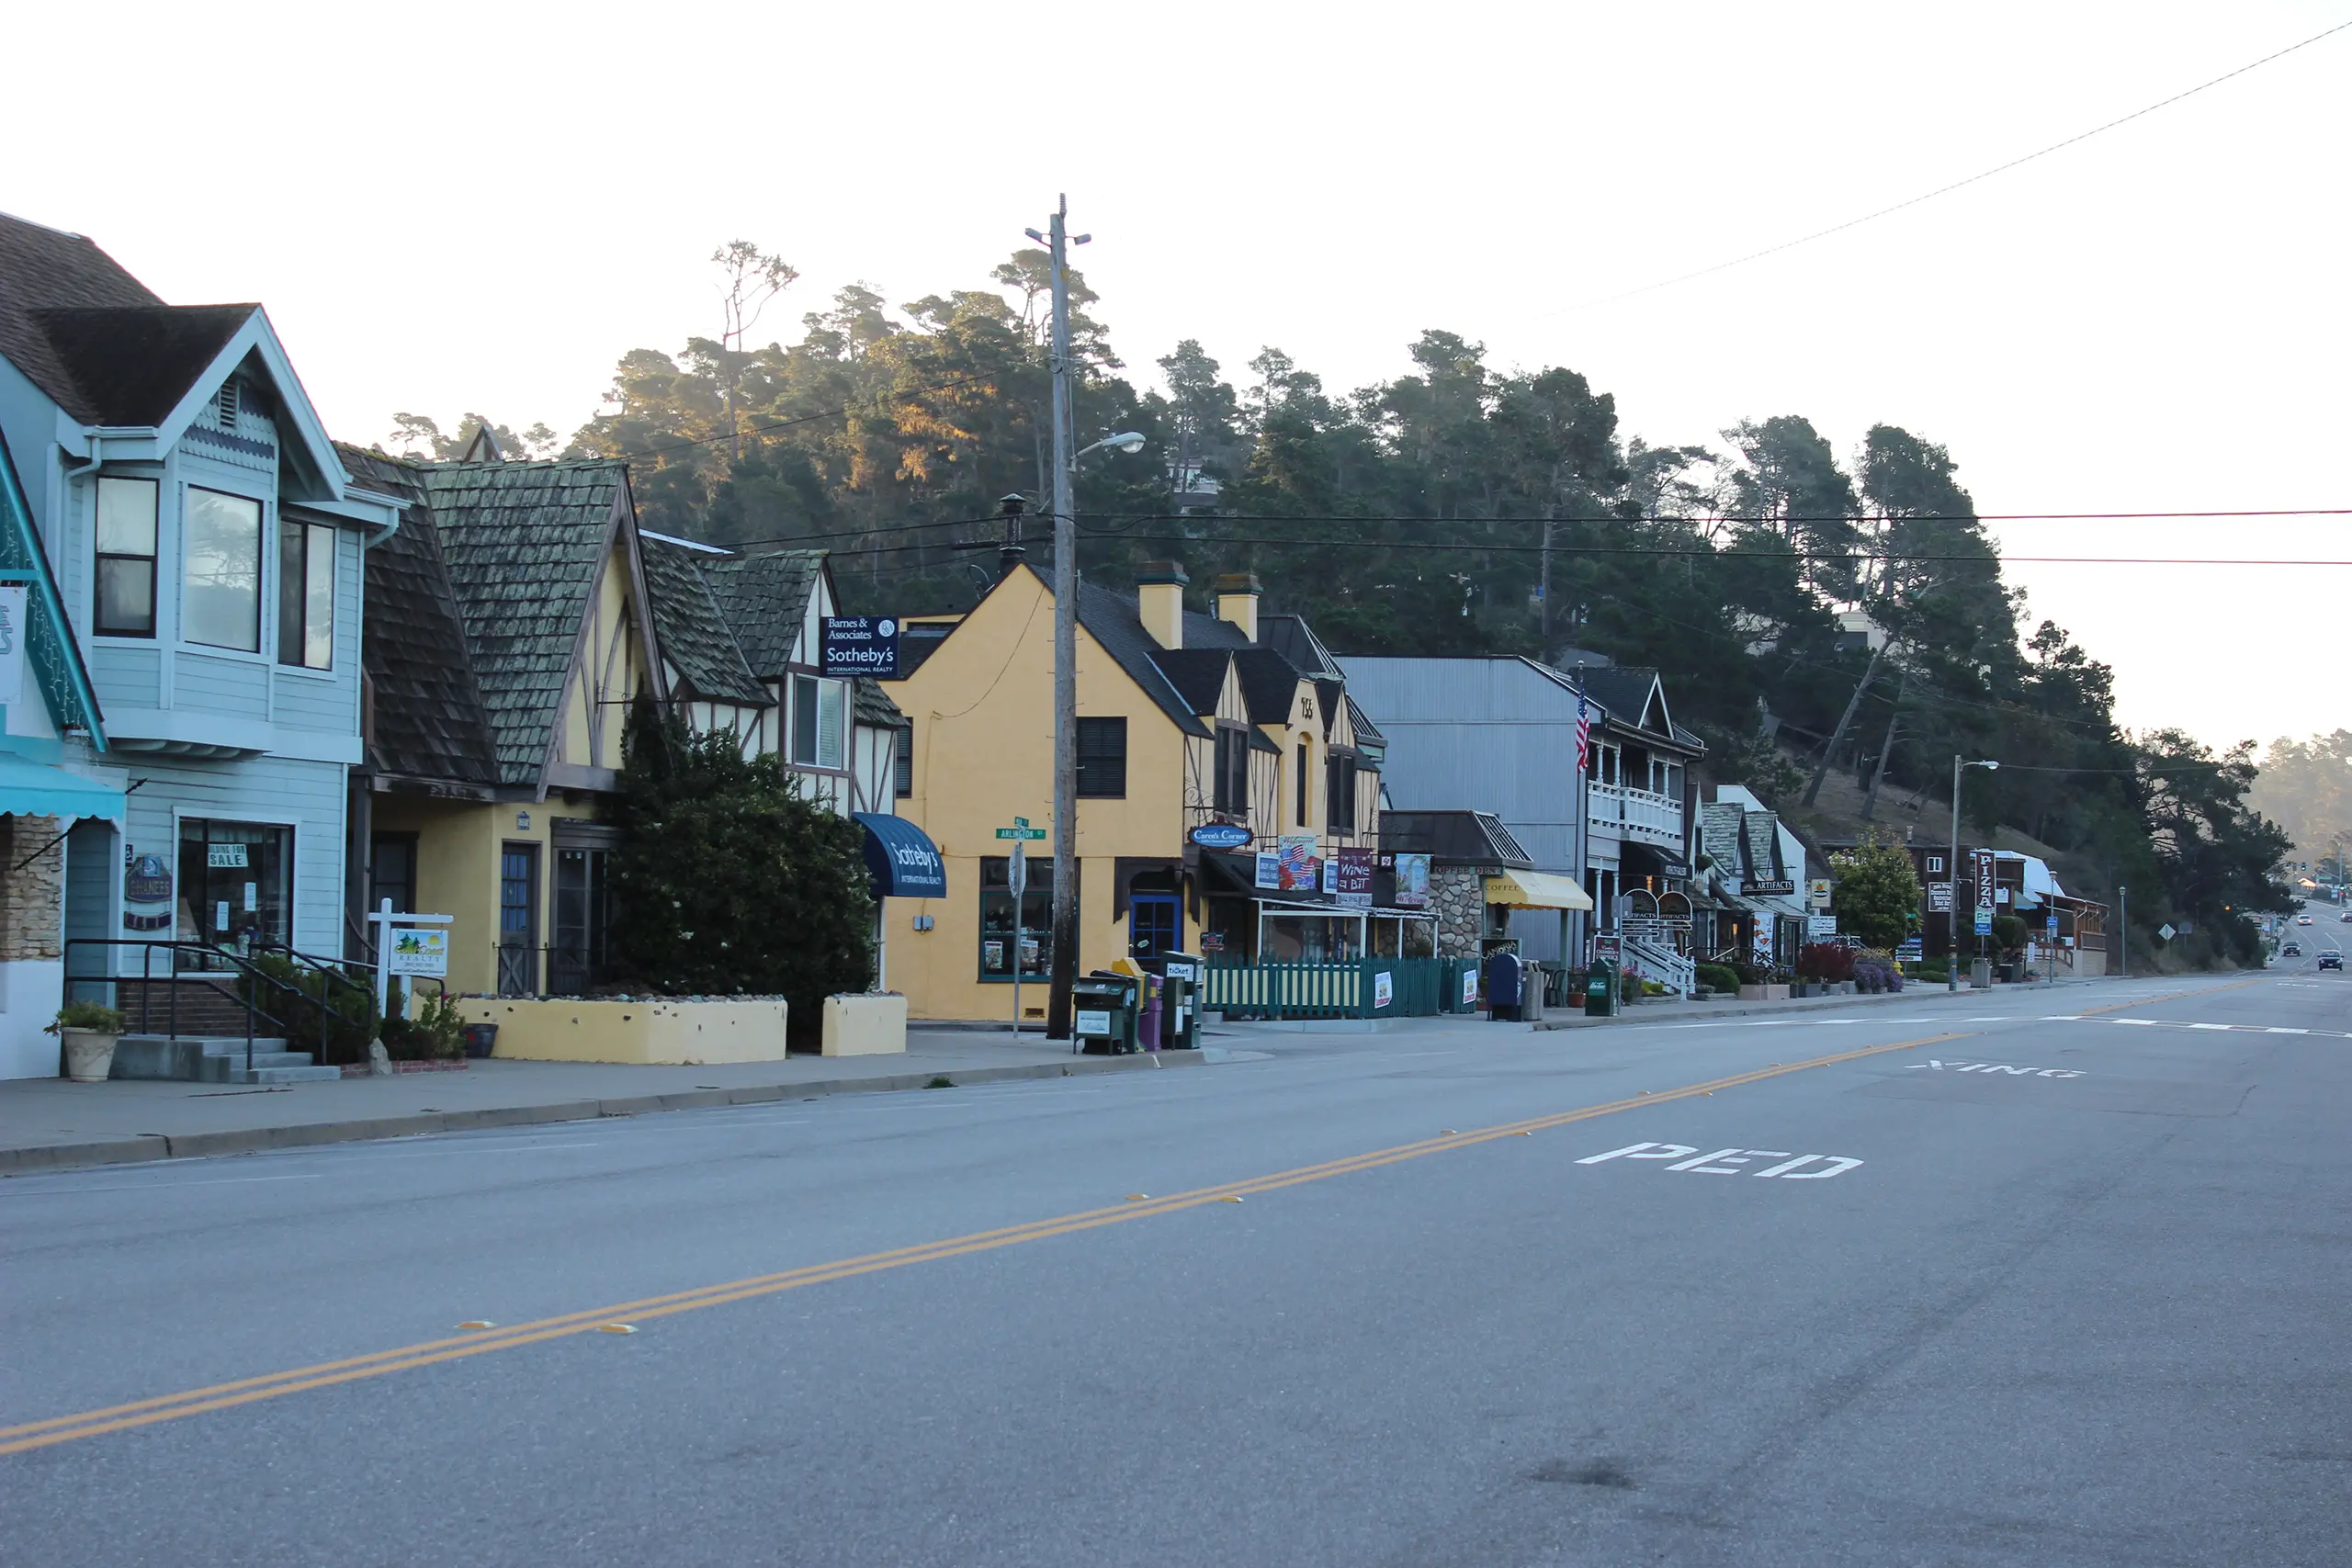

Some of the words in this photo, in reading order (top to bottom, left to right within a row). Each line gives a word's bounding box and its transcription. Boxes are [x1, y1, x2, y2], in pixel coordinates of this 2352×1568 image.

[828, 618, 857, 627] Barnes
[859, 618, 868, 627] &
[828, 630, 872, 639] Associates
[827, 647, 894, 666] Sotheby's
[1001, 829, 1034, 839] ARLINGTON
[1194, 830, 1219, 840] Caren's
[1221, 830, 1247, 840] Corner
[232, 845, 245, 854] FOR
[210, 854, 242, 865] SALE
[890, 841, 938, 874] Sotheby's
[1339, 879, 1347, 889] a
[1757, 881, 1792, 889] ARTIFACTS
[1979, 855, 1992, 907] PIZZA
[1977, 913, 1983, 921] P
[1904, 1060, 2087, 1078] XING
[1573, 1142, 1864, 1179] PED
